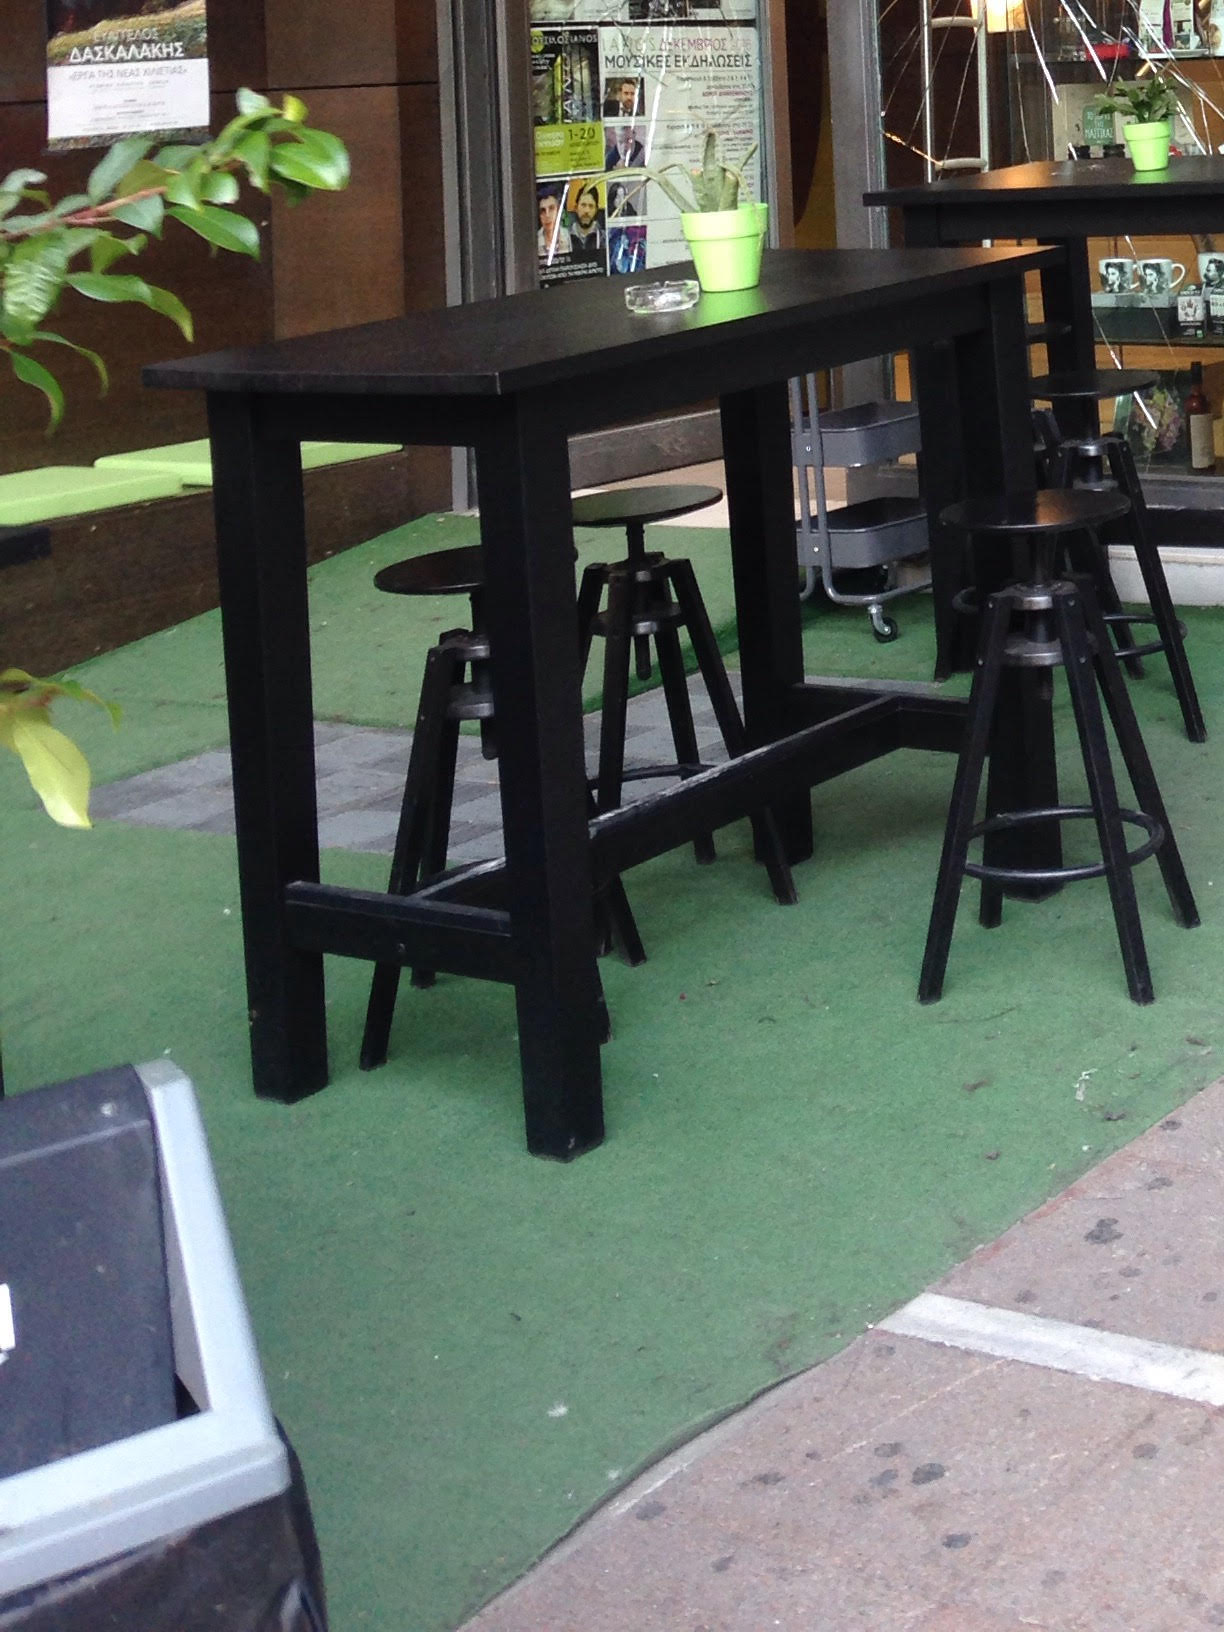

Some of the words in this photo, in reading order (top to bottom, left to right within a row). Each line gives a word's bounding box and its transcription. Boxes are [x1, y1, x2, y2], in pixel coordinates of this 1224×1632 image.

[69, 42, 184, 63] ΔΑΣΚΑΛΑΚΗΣ
[605, 55, 672, 68] ΜΟΥΣΙΚΕΣ
[674, 55, 752, 68] ΕΚΔΗΛΩΣΕΙΣ
